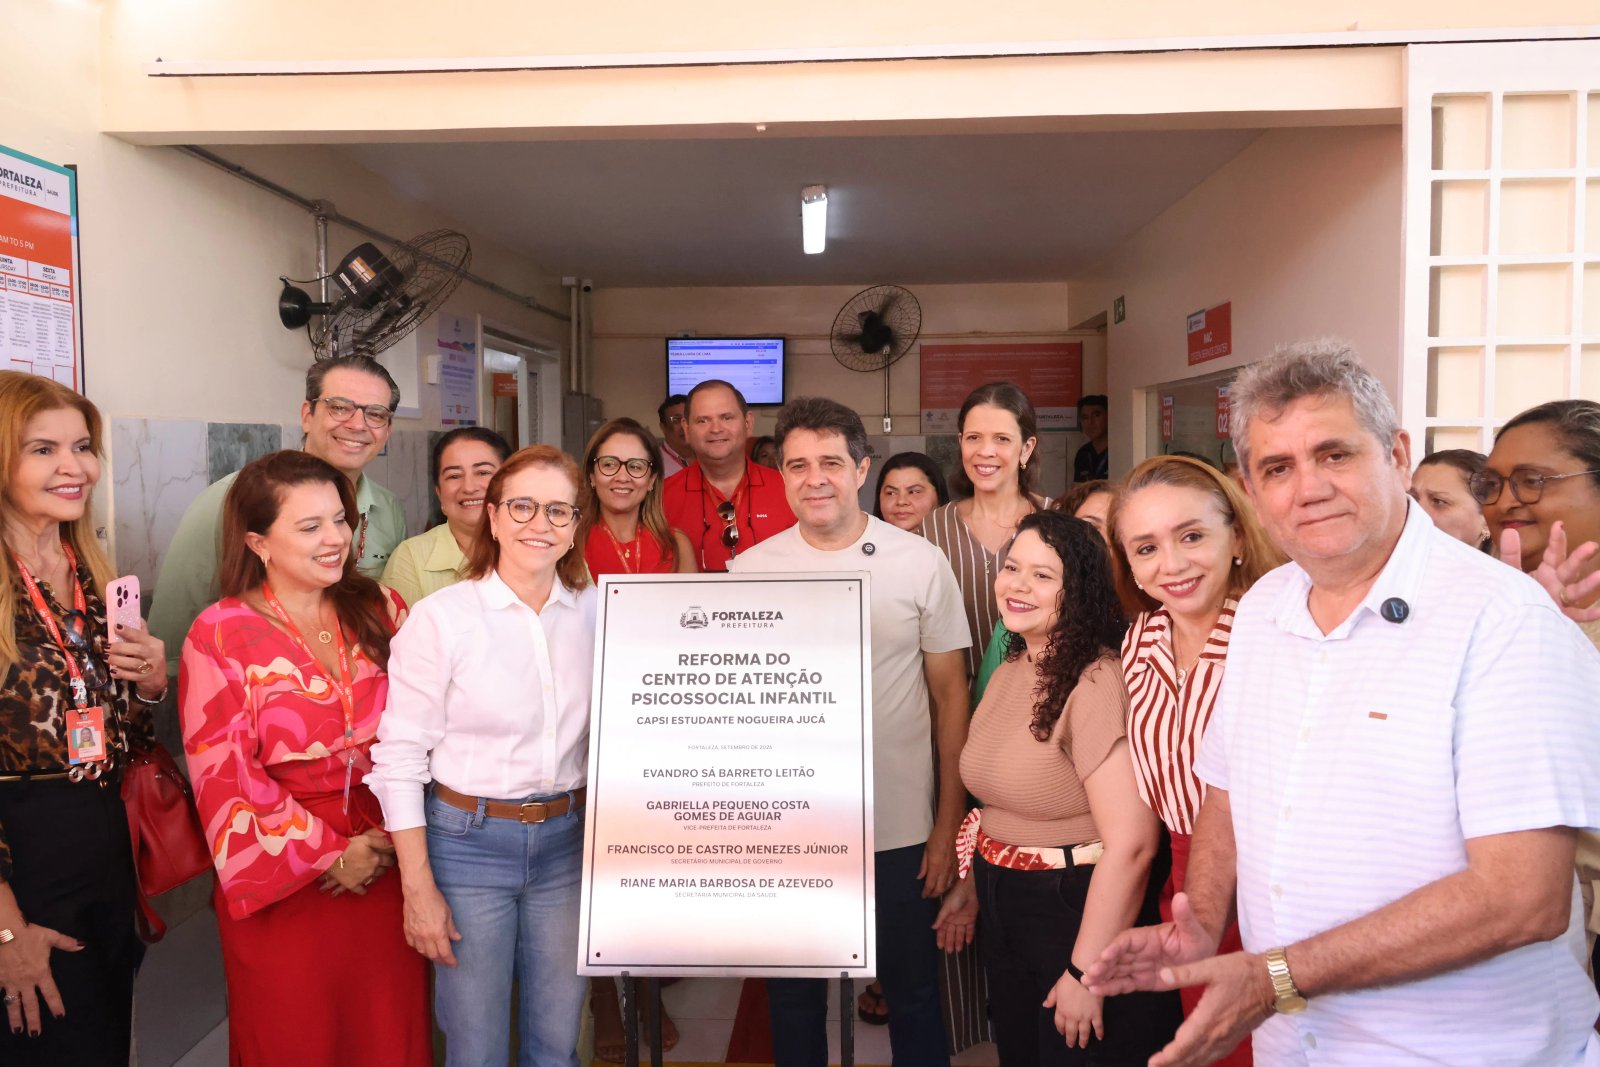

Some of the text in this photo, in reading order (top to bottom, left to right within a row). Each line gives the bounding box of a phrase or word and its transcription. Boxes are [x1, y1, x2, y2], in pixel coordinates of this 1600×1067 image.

[10, 237, 19, 246] TO
[25, 241, 35, 250] PM
[1218, 412, 1228, 433] 02
[712, 611, 784, 621] FORTALEZA
[678, 653, 791, 666] REFORMA DO
[641, 668, 823, 688] CENTRO DE ATENÇÃO
[631, 691, 837, 705] PSICOSSOCIAL INFANTIL
[636, 713, 826, 725] CAPSI ESTUDANTE NOGUEIRA JUCÁ
[643, 766, 815, 778] EVANDRO SÁ BARRETO LEITÃO
[646, 800, 811, 811] GABRIELLA PEQUENO COSTA
[673, 811, 782, 821] GOMES DE AGUIAR
[607, 842, 849, 855] FRANCISCO DE CASTRO MENEZES JÚNIOR
[671, 857, 708, 865] SECRETÁRIO
[620, 878, 834, 889] RIANE MARIA BARBOSA DE AZEVEDO
